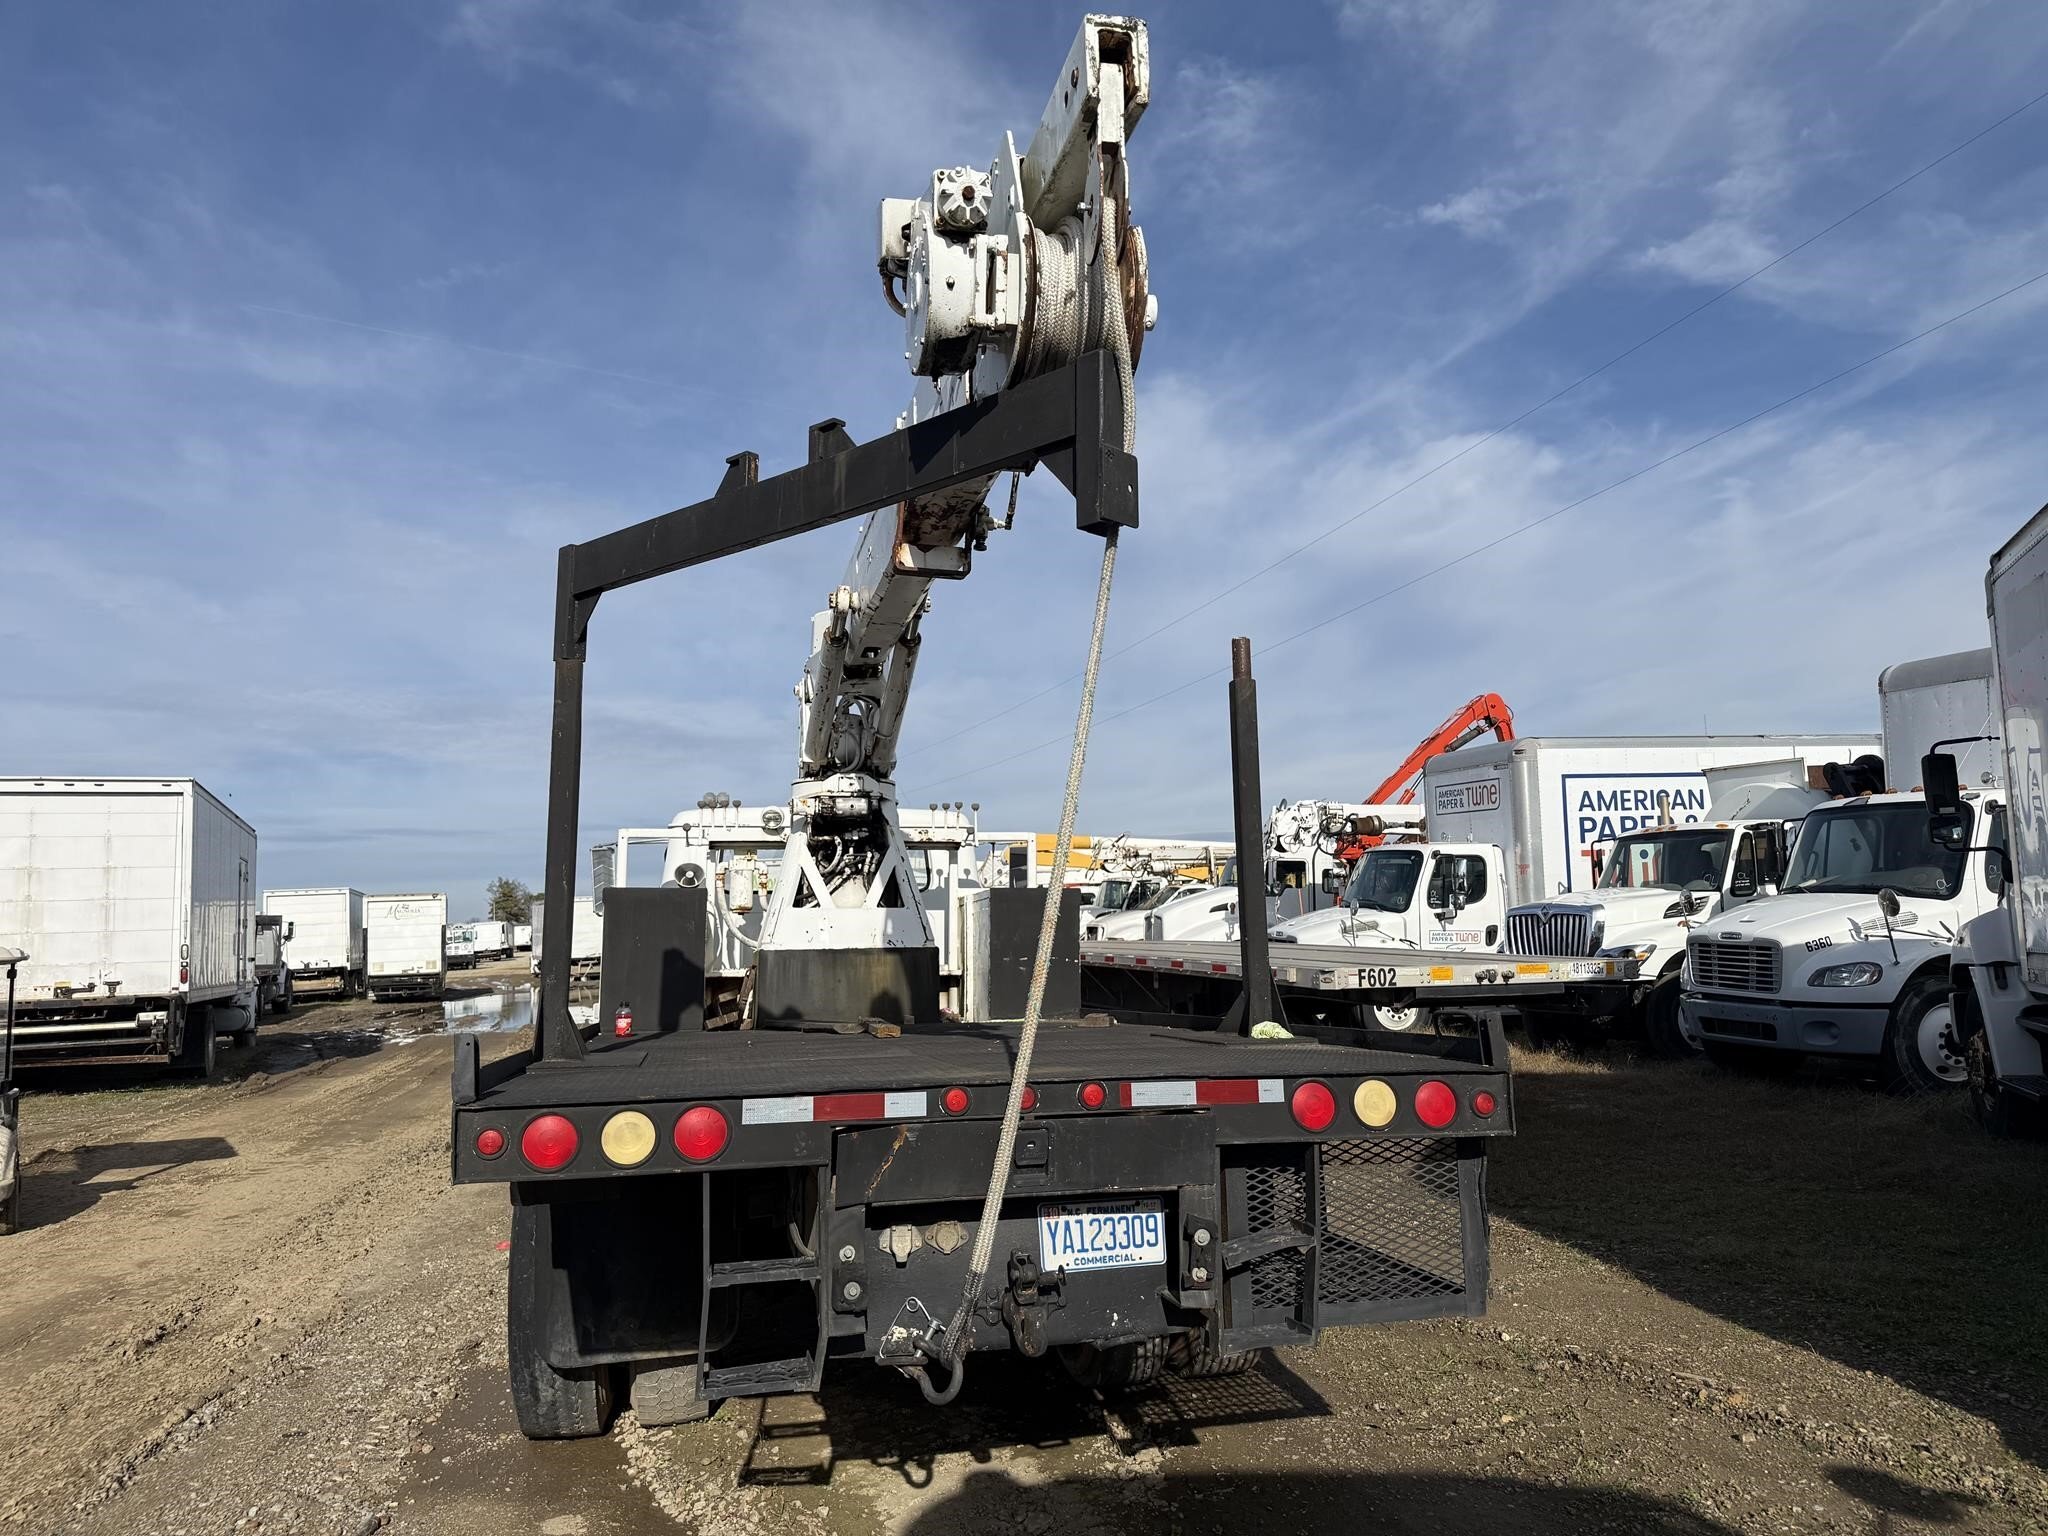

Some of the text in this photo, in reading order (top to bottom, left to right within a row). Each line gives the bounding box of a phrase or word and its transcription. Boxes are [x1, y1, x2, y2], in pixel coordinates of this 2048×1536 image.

[1438, 787, 1465, 799] AMERICAN
[1578, 788, 1705, 812] AMERICAN
[1438, 798, 1465, 810] PAPER &
[1804, 935, 1833, 953] 6360
[1358, 967, 1397, 987] F602
[1086, 1204, 1136, 1215] PERMANENT
[1046, 1214, 1159, 1256] YA123309
[1073, 1253, 1136, 1266] COMMERCIAL
